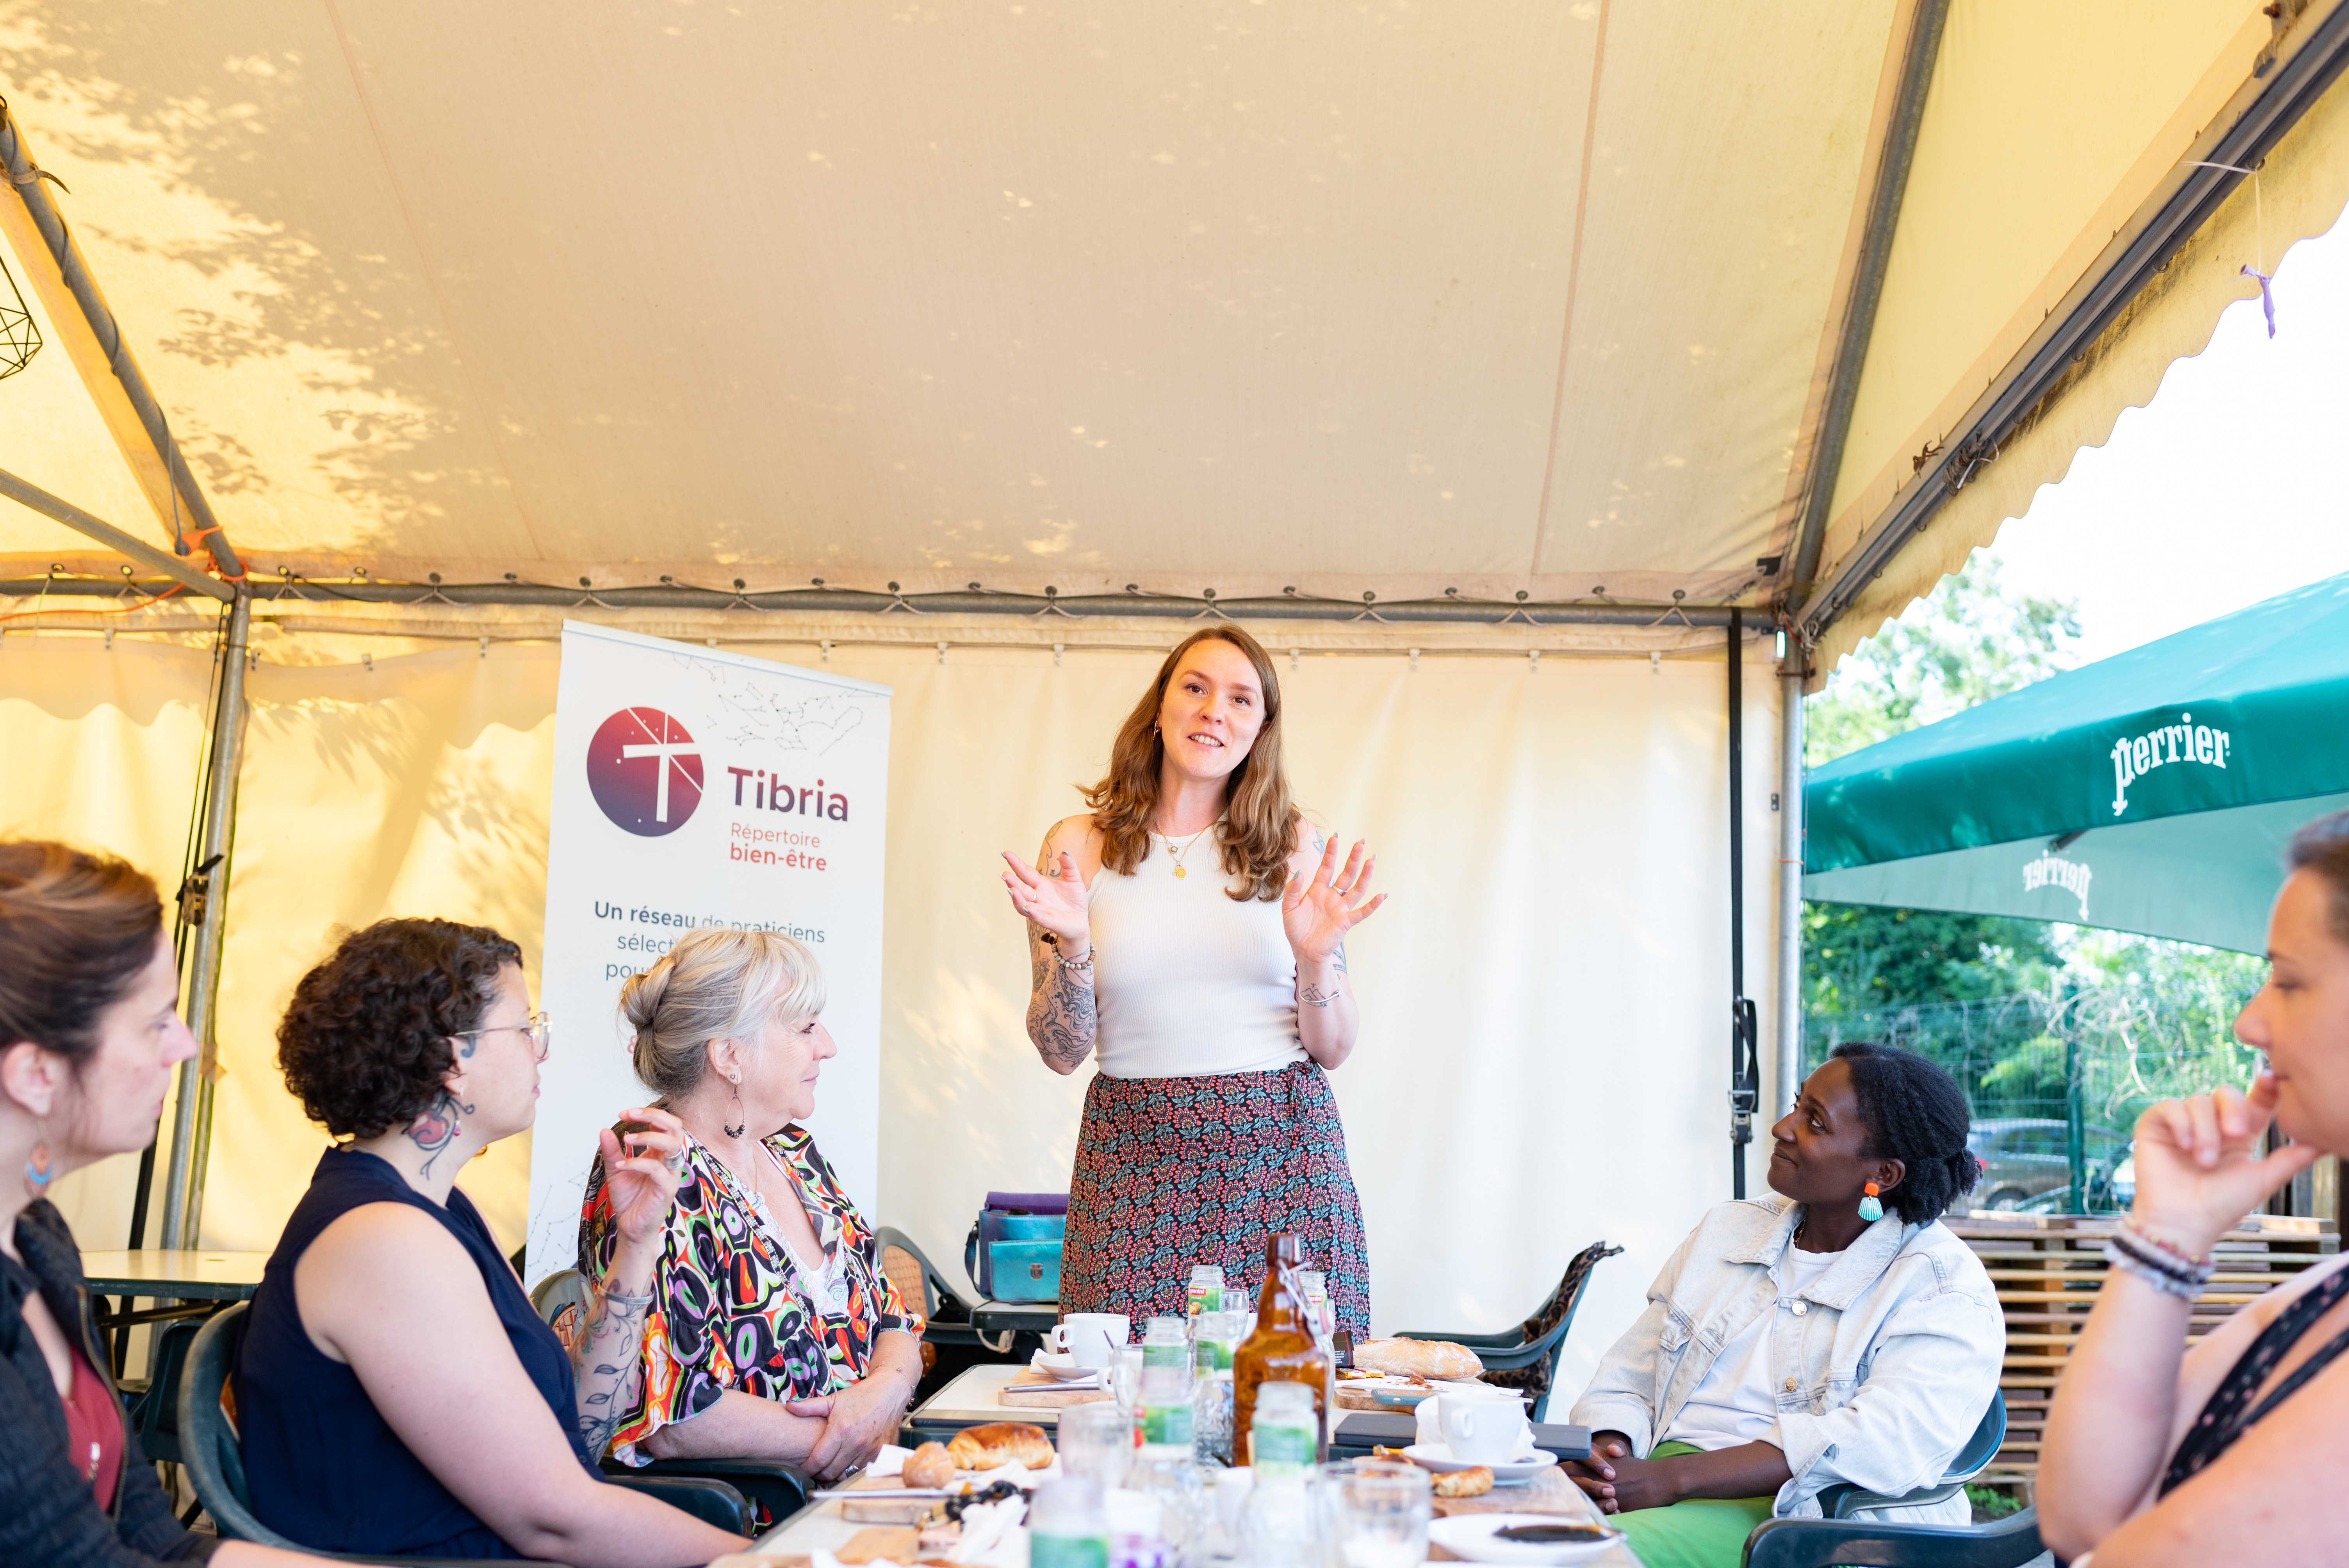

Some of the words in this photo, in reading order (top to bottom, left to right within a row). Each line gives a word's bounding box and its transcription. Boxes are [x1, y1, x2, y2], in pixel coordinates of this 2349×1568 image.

[2110, 712, 2229, 816] perrier
[727, 766, 848, 821] Tibria
[731, 822, 820, 848] Répertoire
[730, 842, 827, 871] bien-être
[595, 901, 622, 920] Un
[631, 905, 695, 928] réseau
[617, 933, 679, 953] sélect
